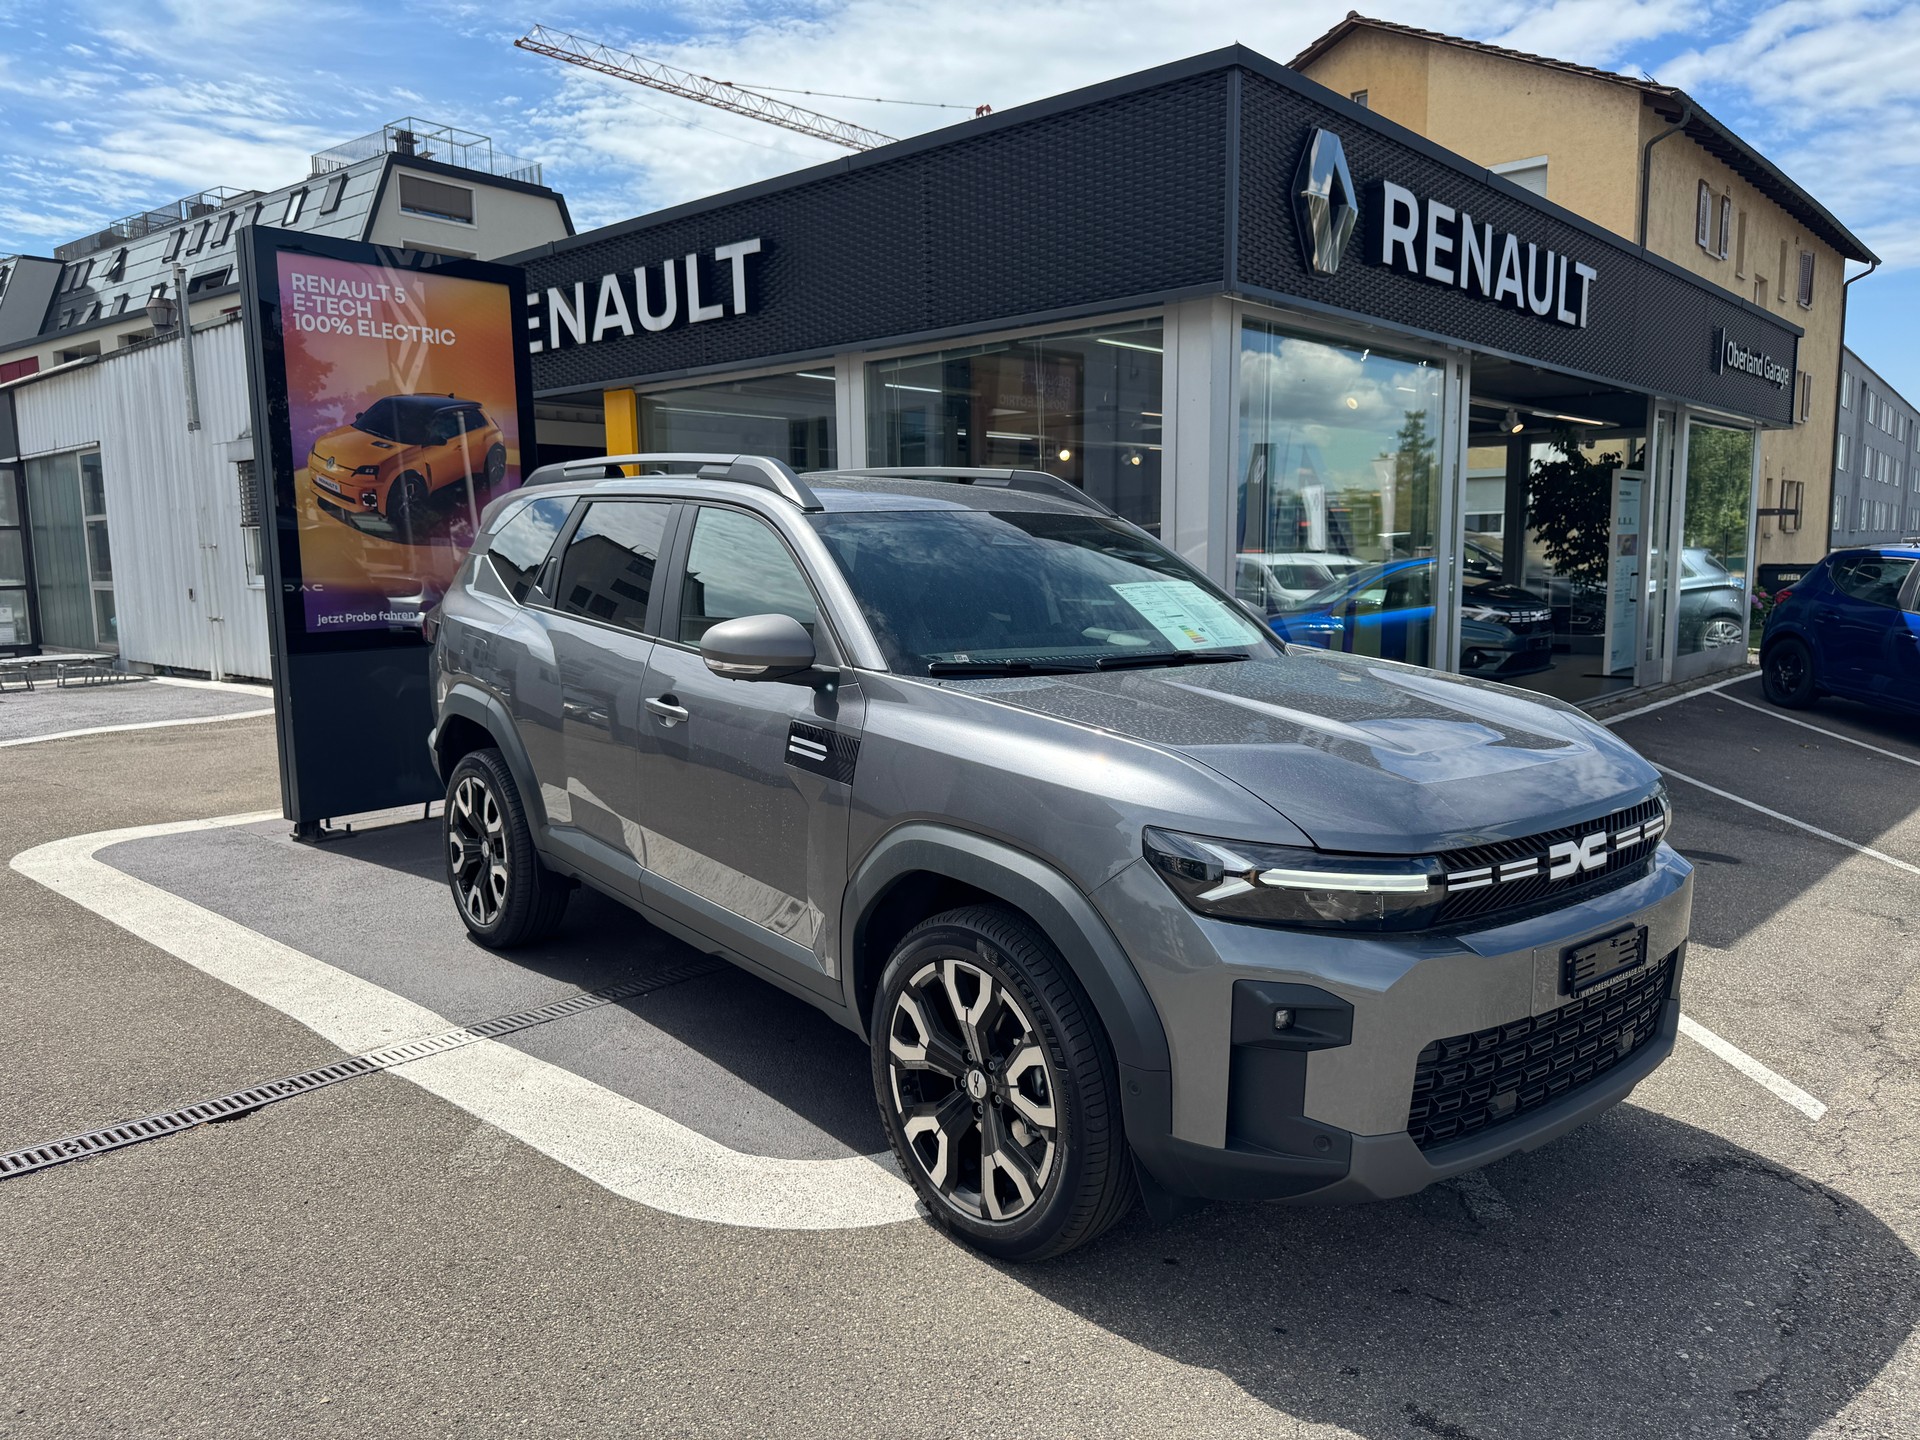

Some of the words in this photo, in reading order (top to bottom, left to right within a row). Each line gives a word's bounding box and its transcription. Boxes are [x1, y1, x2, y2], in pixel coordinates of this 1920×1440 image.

[1382, 179, 1598, 329] RENAULT
[291, 272, 390, 302] RENAULT
[394, 287, 406, 305] 5
[293, 293, 372, 318] E-TECH
[526, 237, 761, 354] ENAULT
[292, 312, 353, 336] 100%
[358, 319, 456, 345] ELECTRIC
[1727, 341, 1764, 377] Oberland
[1764, 355, 1789, 390] Garage
[316, 614, 344, 627] jetzt
[345, 612, 377, 624] Probe
[378, 611, 416, 622] fahren
[999, 961, 1066, 1067] MICHELIN
